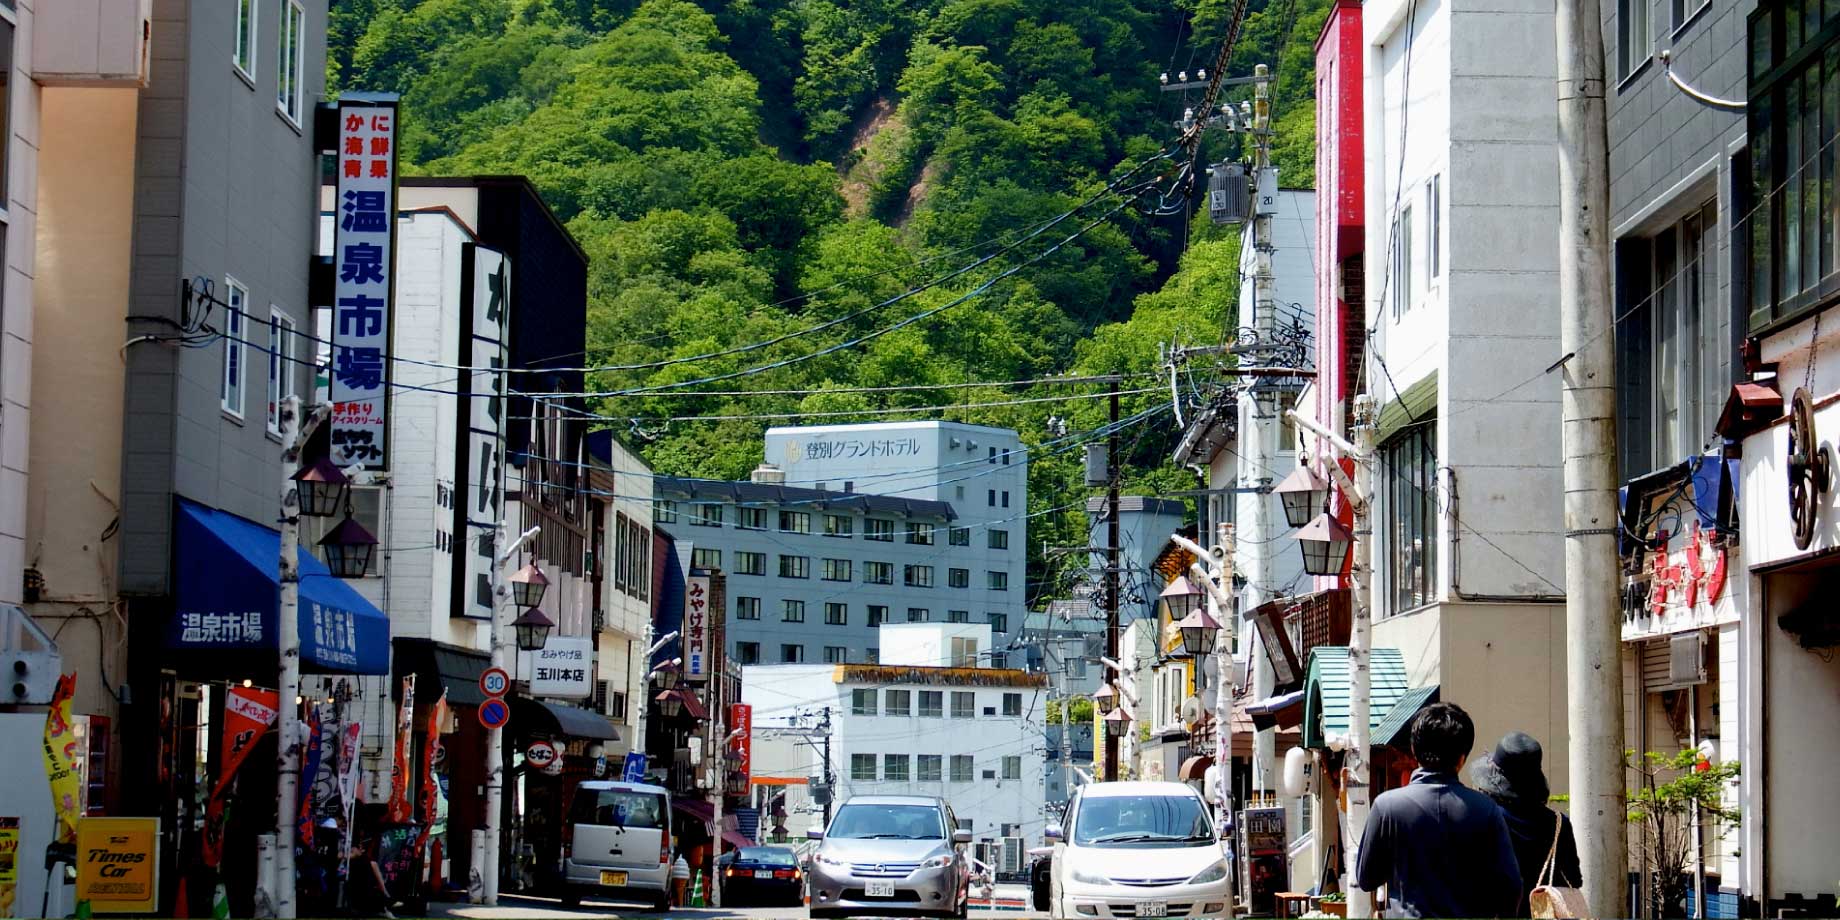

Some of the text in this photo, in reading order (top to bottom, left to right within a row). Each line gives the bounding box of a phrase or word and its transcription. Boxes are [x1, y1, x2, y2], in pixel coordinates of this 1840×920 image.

[345, 114, 389, 132] かに
[345, 136, 389, 155] 海鮮
[344, 160, 388, 178] 青果
[336, 190, 387, 390] 温泉市場
[333, 402, 373, 416] 手作り
[331, 415, 383, 425] アイスクリーム
[806, 438, 921, 461] 登別グランドホテル
[689, 582, 705, 653] みやげ専門
[181, 611, 264, 644] 温泉市場
[540, 649, 583, 661] おみやげ品
[536, 667, 585, 682] 玉川本店
[486, 676, 504, 690] 30
[528, 748, 553, 760] たばこ
[87, 848, 147, 864] Times
[100, 864, 133, 878] Car
